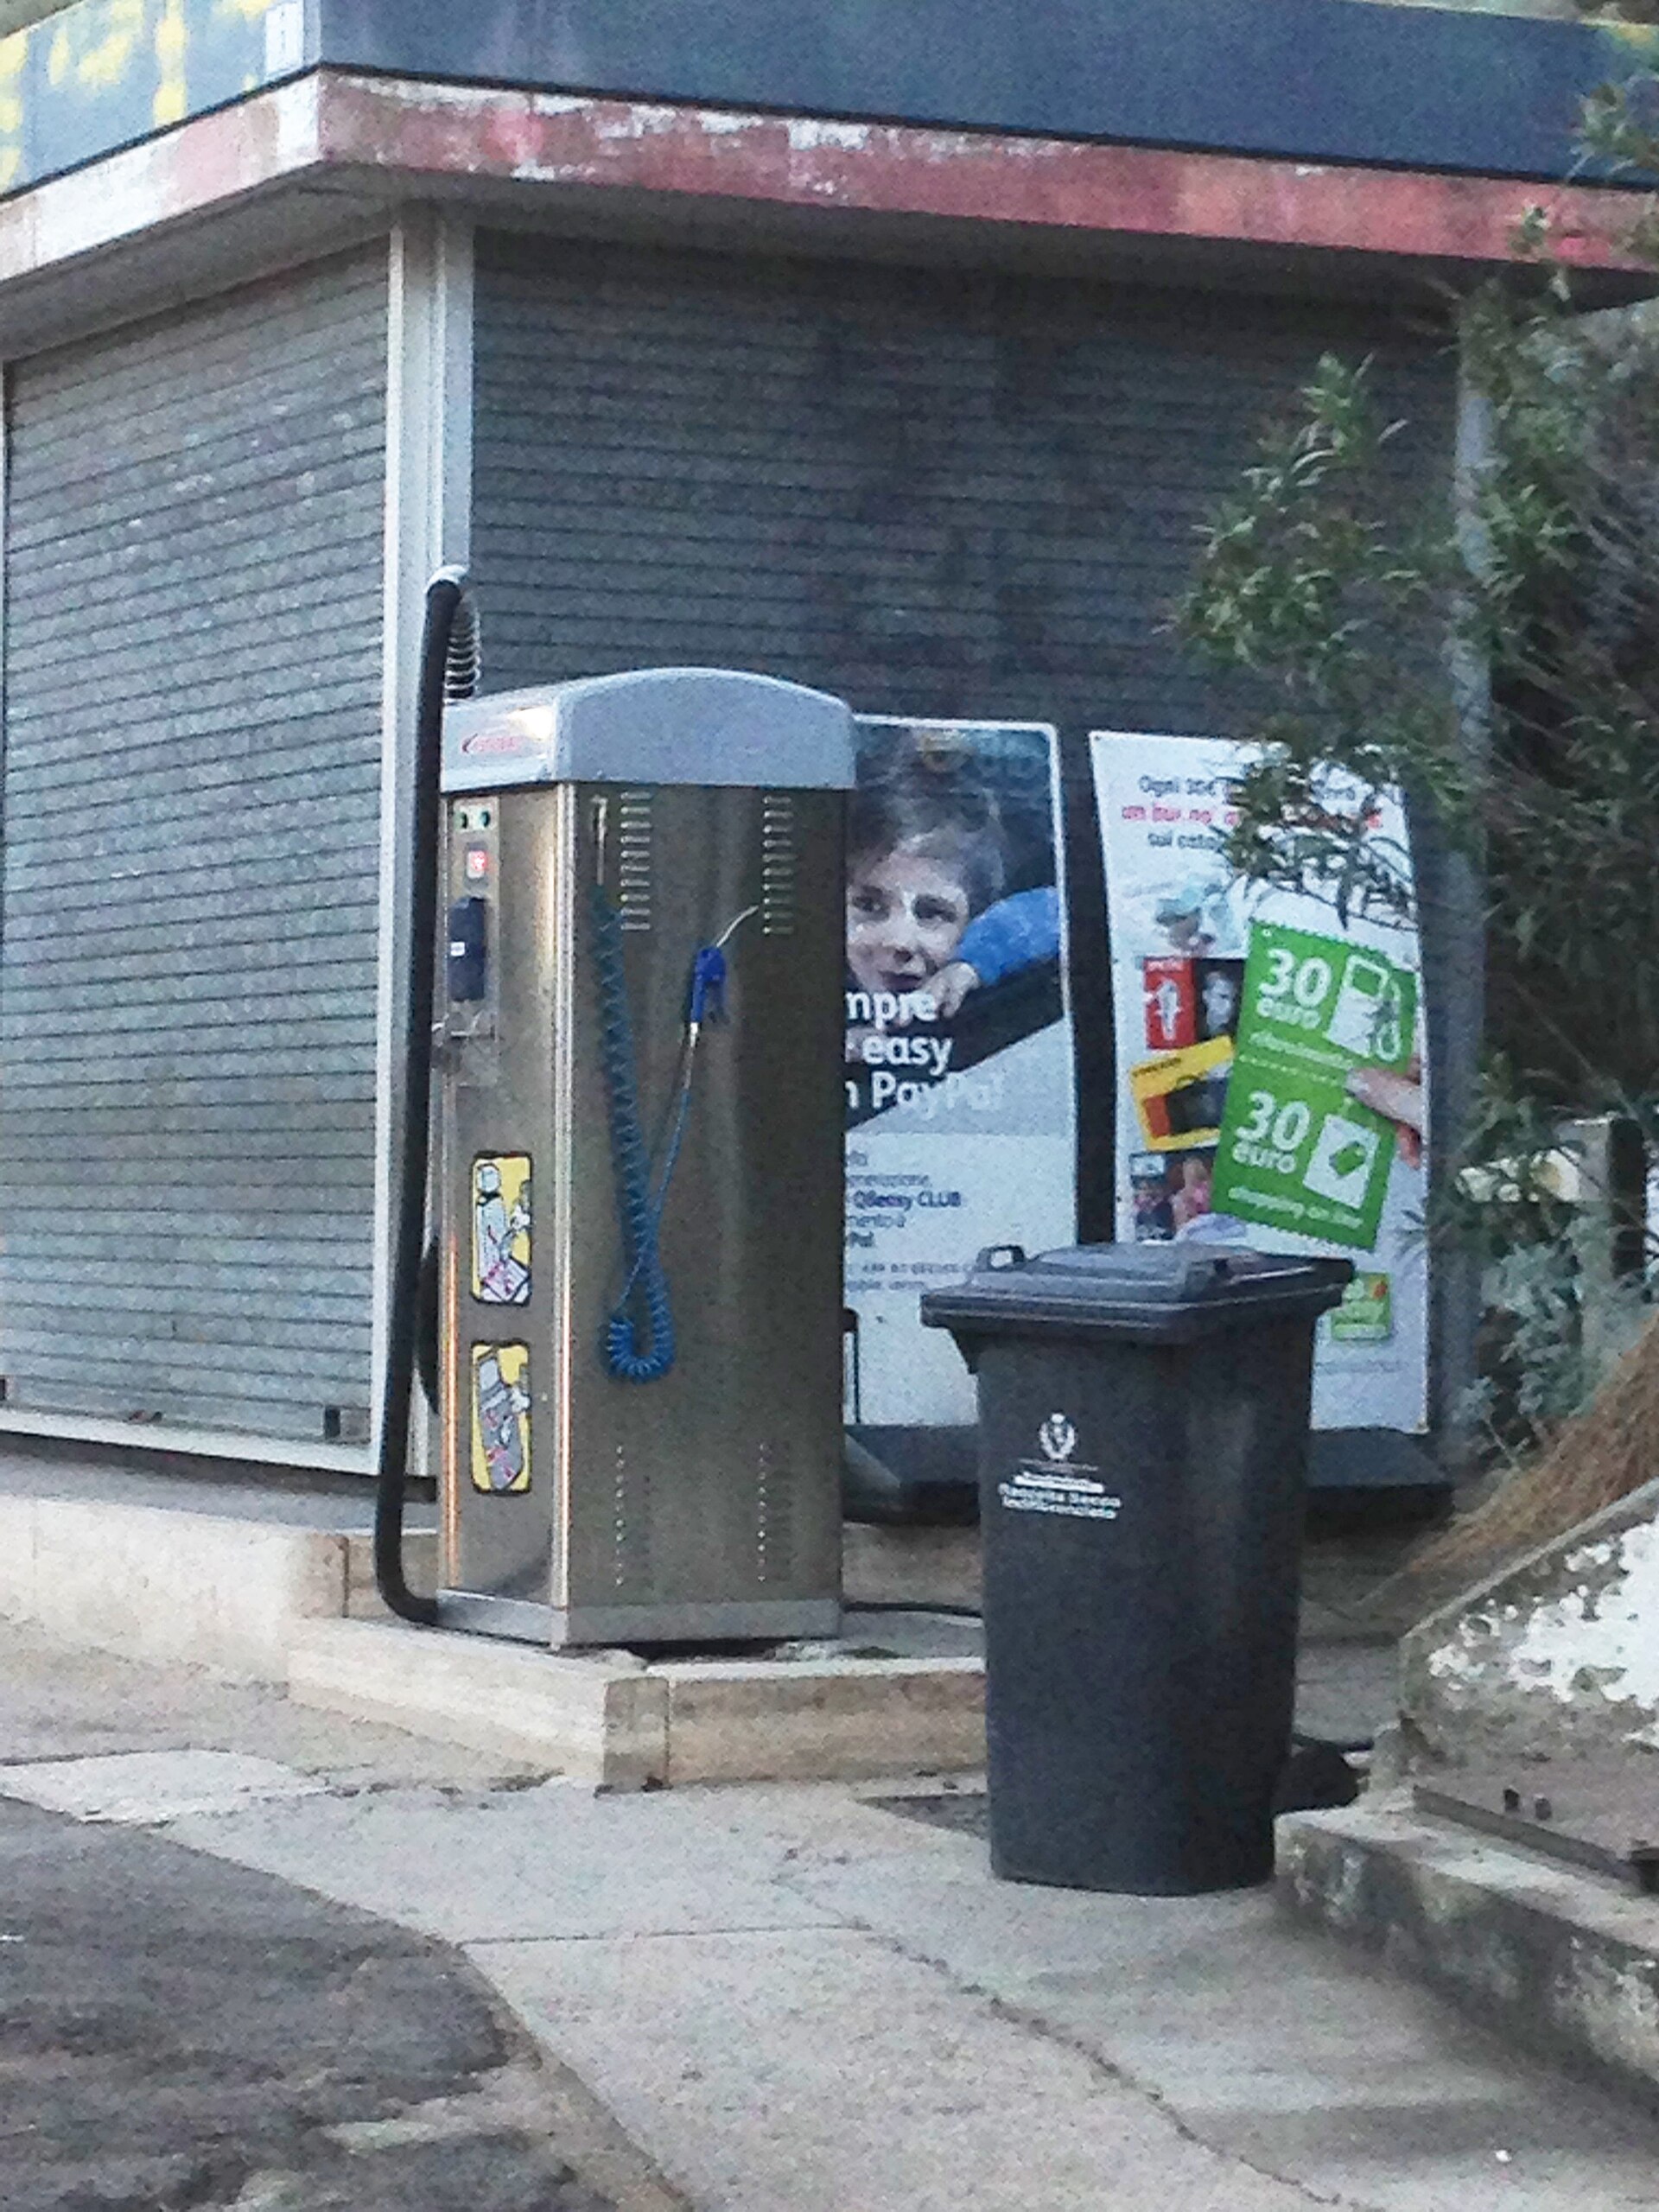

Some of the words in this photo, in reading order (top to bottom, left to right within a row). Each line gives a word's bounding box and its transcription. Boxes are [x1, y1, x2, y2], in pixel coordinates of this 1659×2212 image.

[1259, 949, 1332, 1008] 30
[1256, 997, 1320, 1030] euro
[863, 1036, 952, 1076] easy
[1236, 1090, 1310, 1151] 30
[1232, 1141, 1296, 1173] euro
[917, 1191, 962, 1207] CLUB
